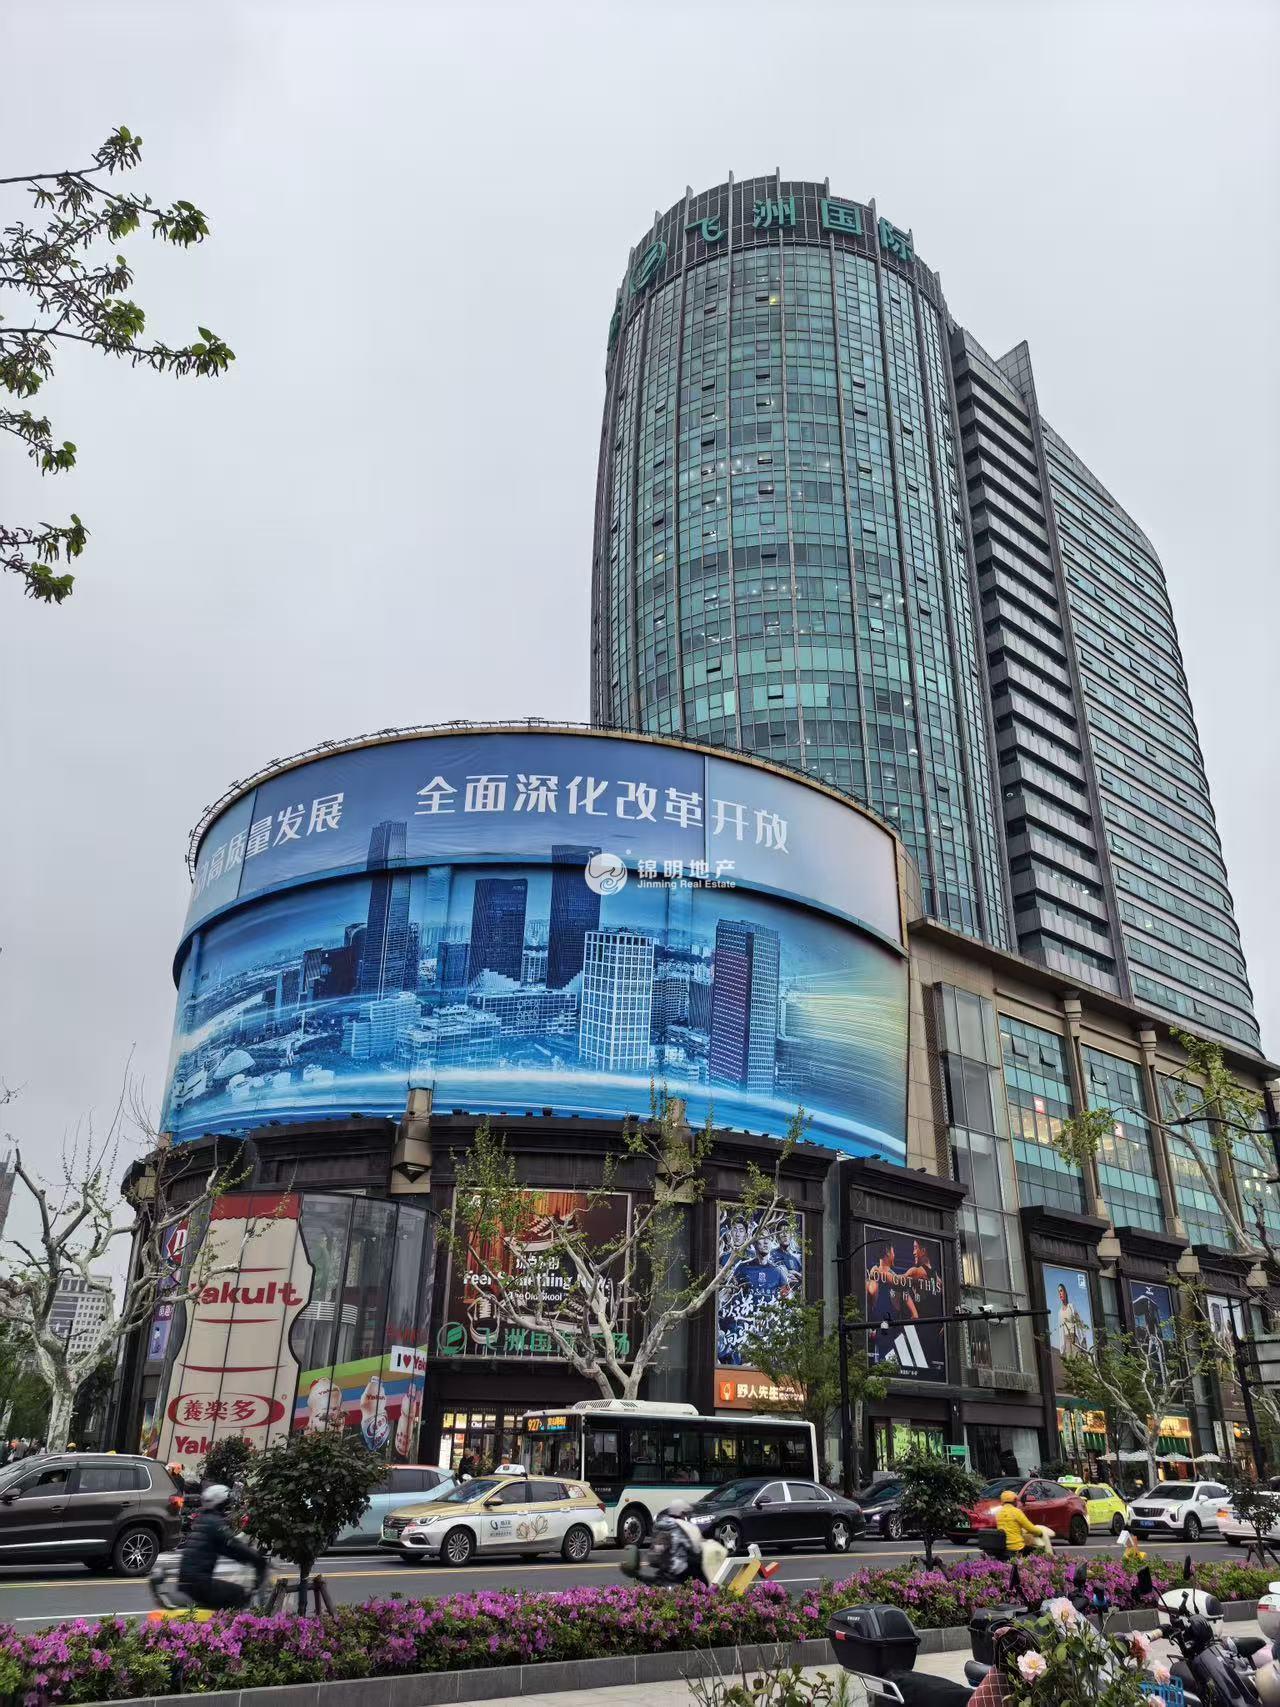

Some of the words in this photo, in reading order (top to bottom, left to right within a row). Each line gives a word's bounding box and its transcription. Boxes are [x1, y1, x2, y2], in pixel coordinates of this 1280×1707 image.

[685, 195, 913, 261] 飞洲国际
[866, 1269, 888, 1283] YOU
[893, 1275, 913, 1288] GOT
[477, 1327, 630, 1356] 飞洲国场
[737, 1383, 779, 1400] 野人先生
[527, 1418, 540, 1431] 927
